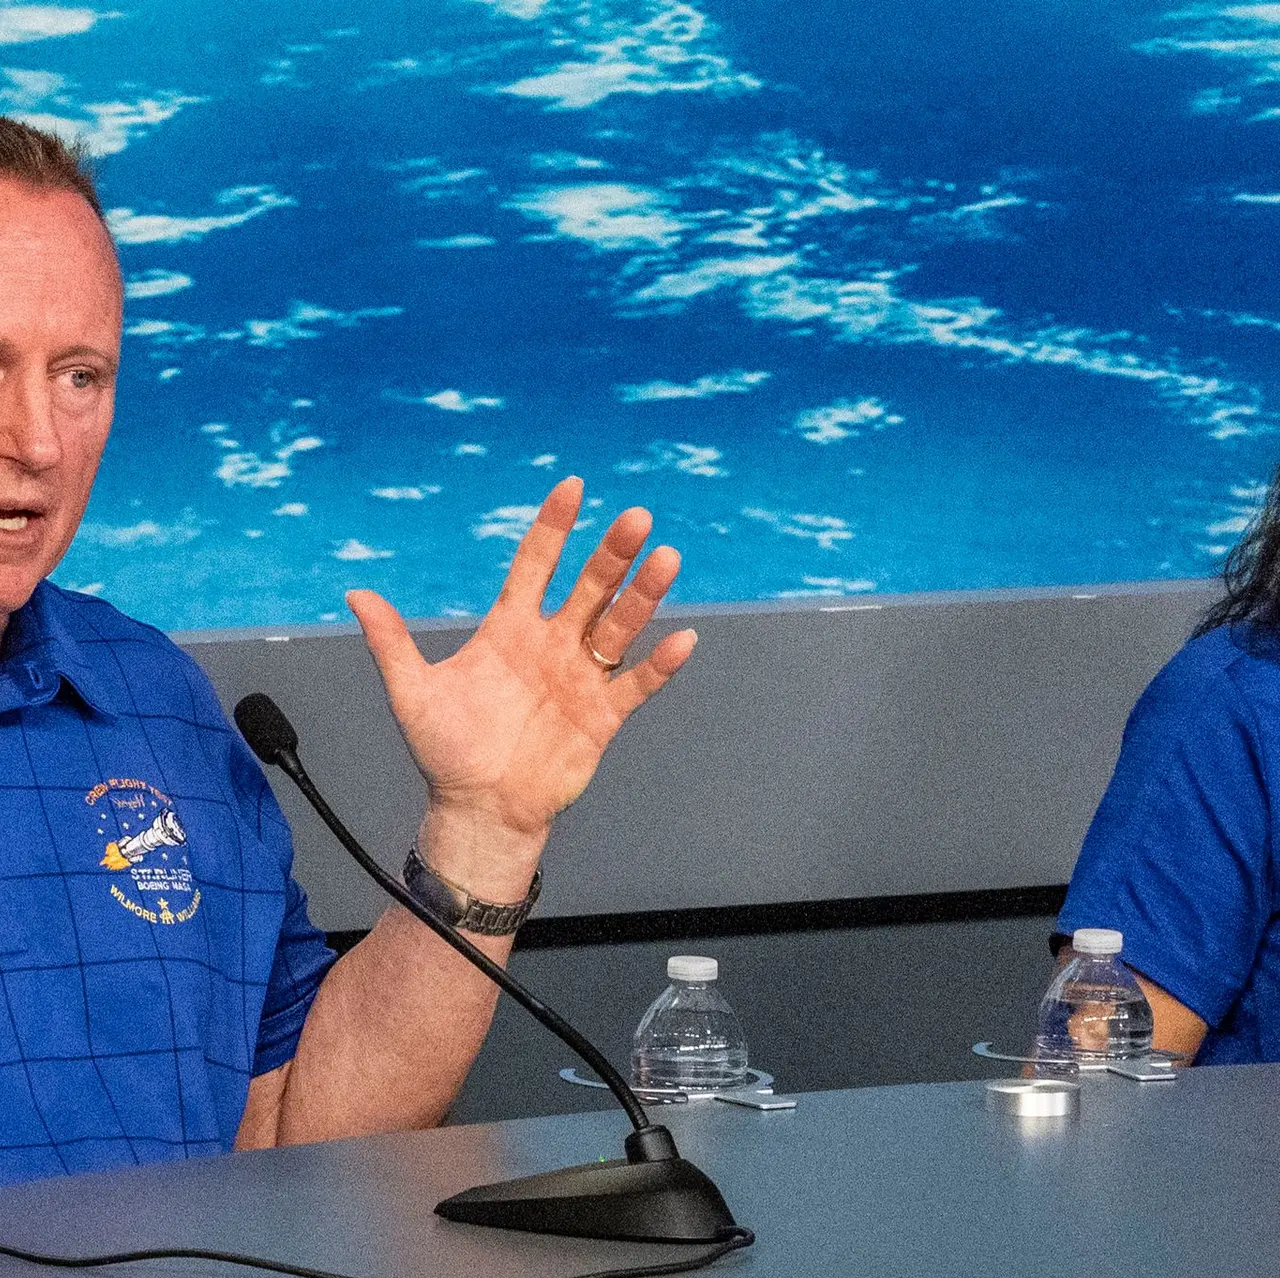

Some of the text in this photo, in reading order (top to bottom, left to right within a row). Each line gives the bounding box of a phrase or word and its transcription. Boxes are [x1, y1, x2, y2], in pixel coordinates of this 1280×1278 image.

[84, 781, 108, 806] CREW
[108, 778, 146, 789] FLIGHT
[137, 881, 171, 891] BOEING
[110, 883, 157, 924] WILMORE
